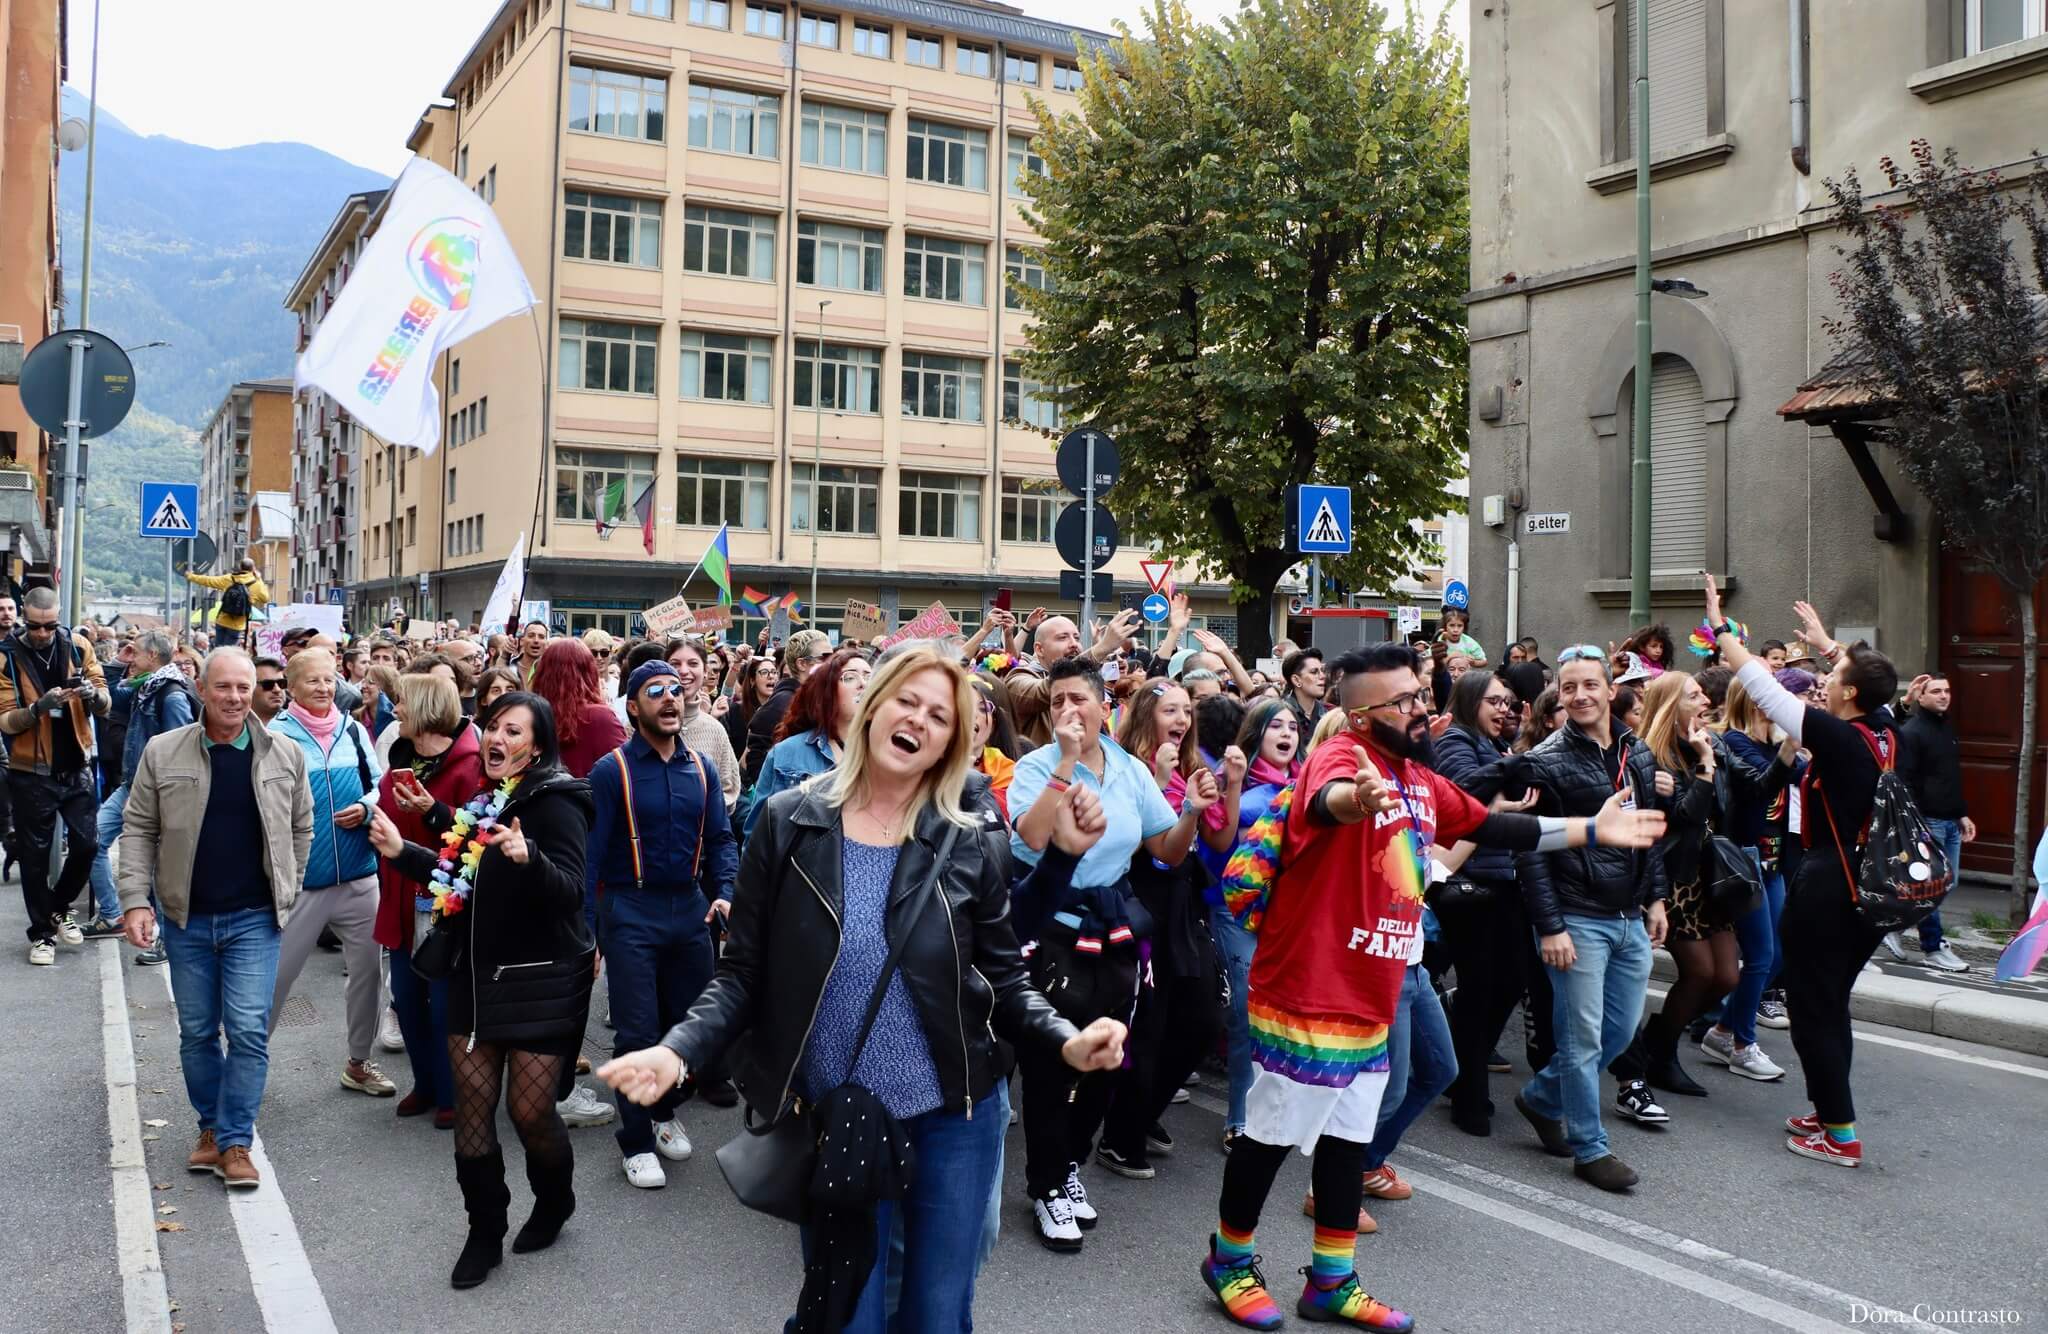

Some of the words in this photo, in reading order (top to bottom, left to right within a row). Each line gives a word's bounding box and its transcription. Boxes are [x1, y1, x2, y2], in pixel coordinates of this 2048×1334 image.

[1528, 515, 1567, 532] g.elter
[847, 599, 866, 610] SONO
[258, 629, 284, 647] SIAM
[1376, 916, 1413, 936] DELLA
